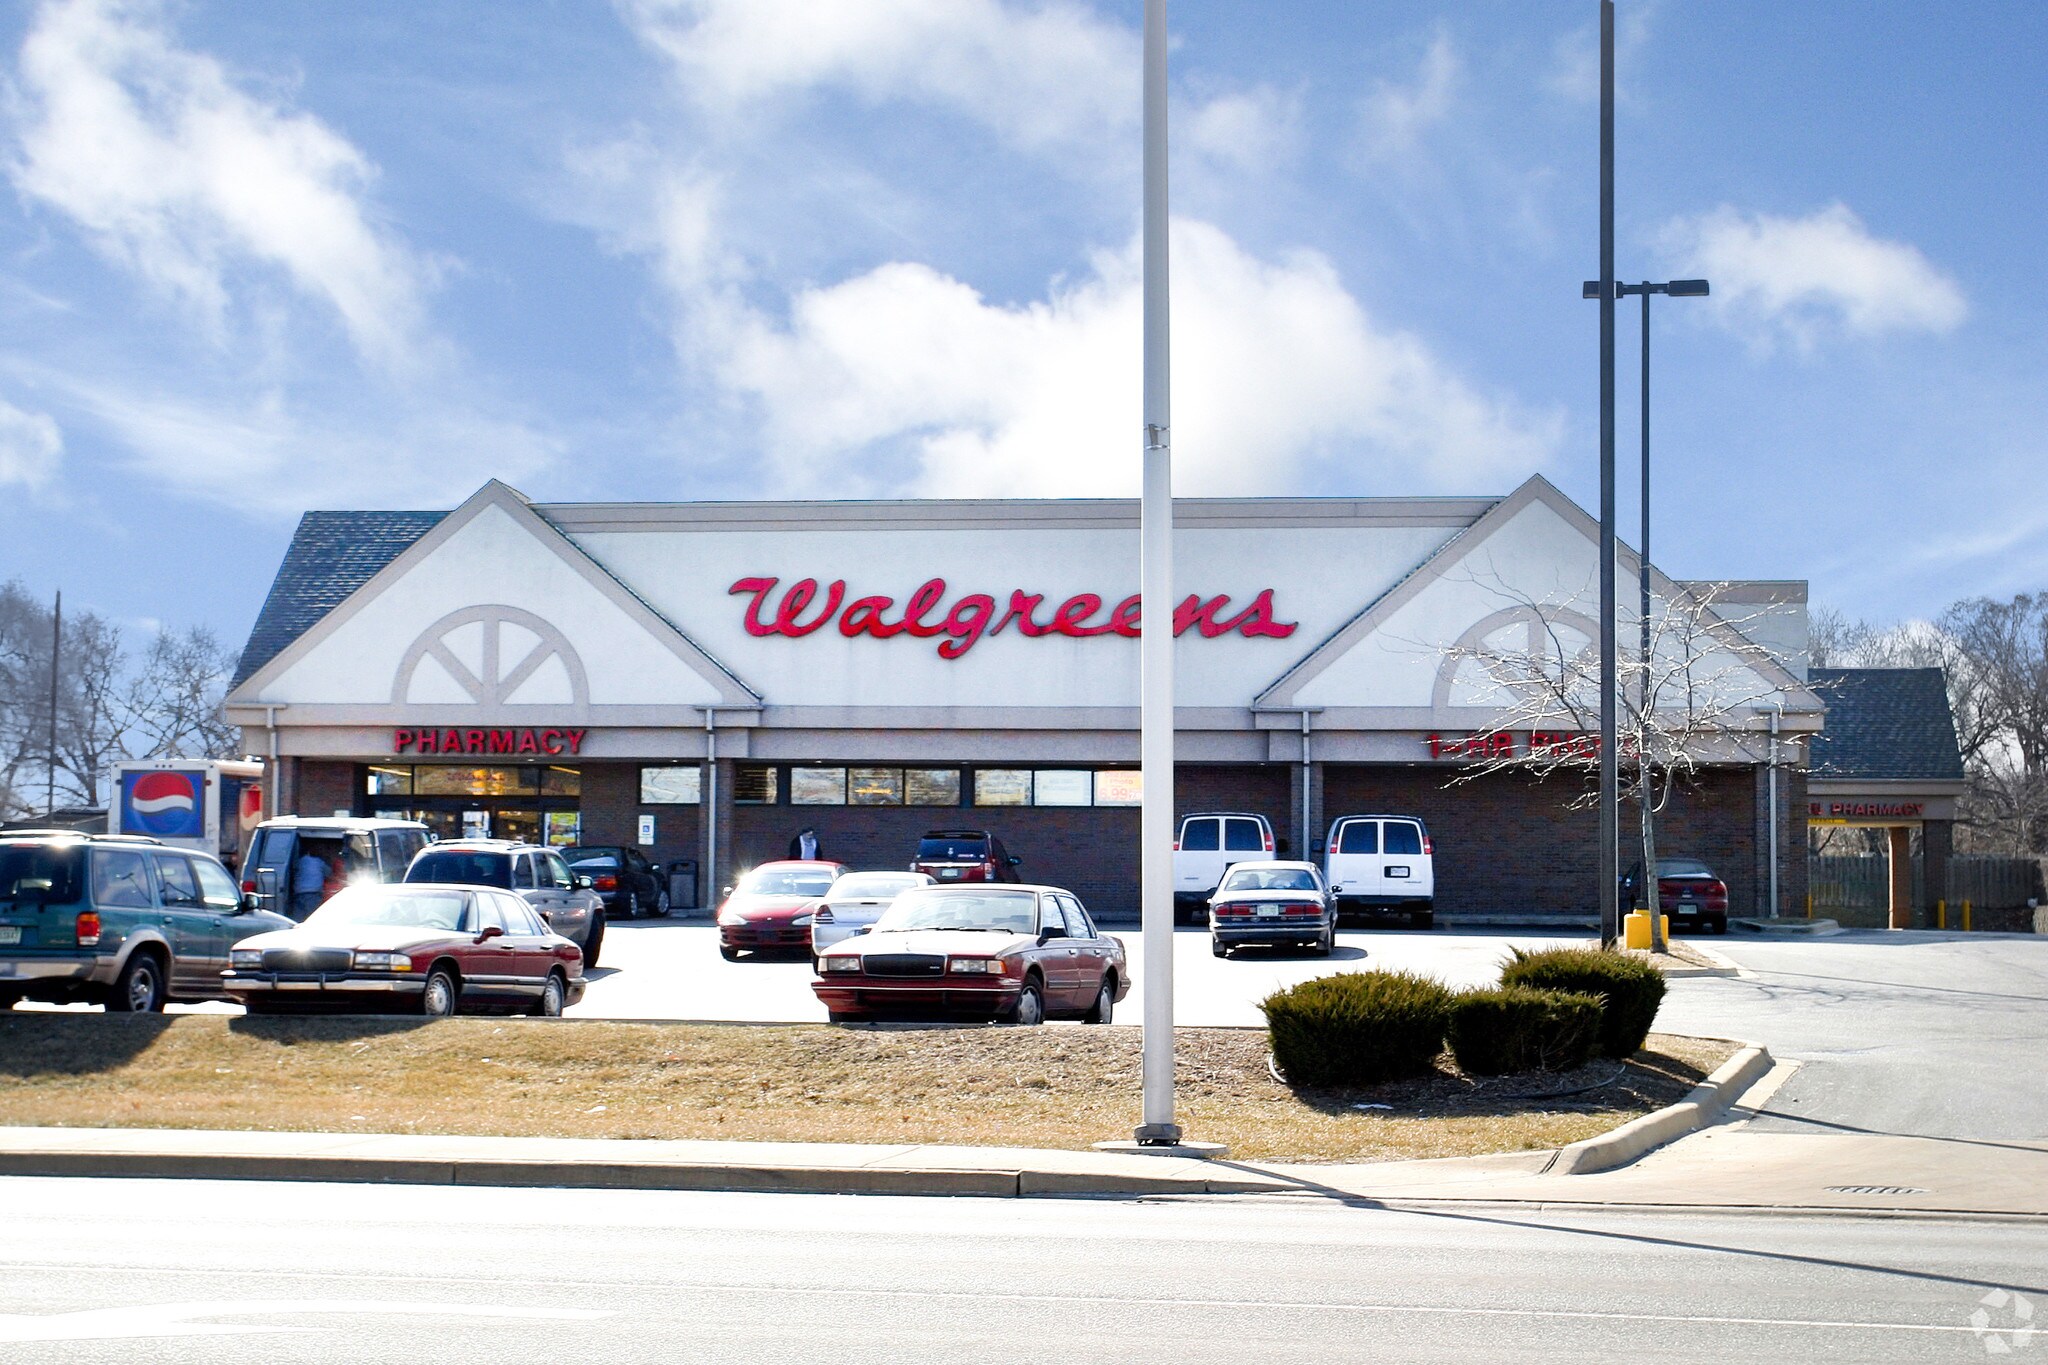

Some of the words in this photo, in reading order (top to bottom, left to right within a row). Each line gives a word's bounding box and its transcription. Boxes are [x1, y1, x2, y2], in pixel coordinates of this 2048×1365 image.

[728, 577, 1299, 659] Walgreens
[394, 729, 586, 755] PHARMACY
[1427, 733, 1513, 759] 1-HR
[1830, 802, 1926, 817] PHARMACY
